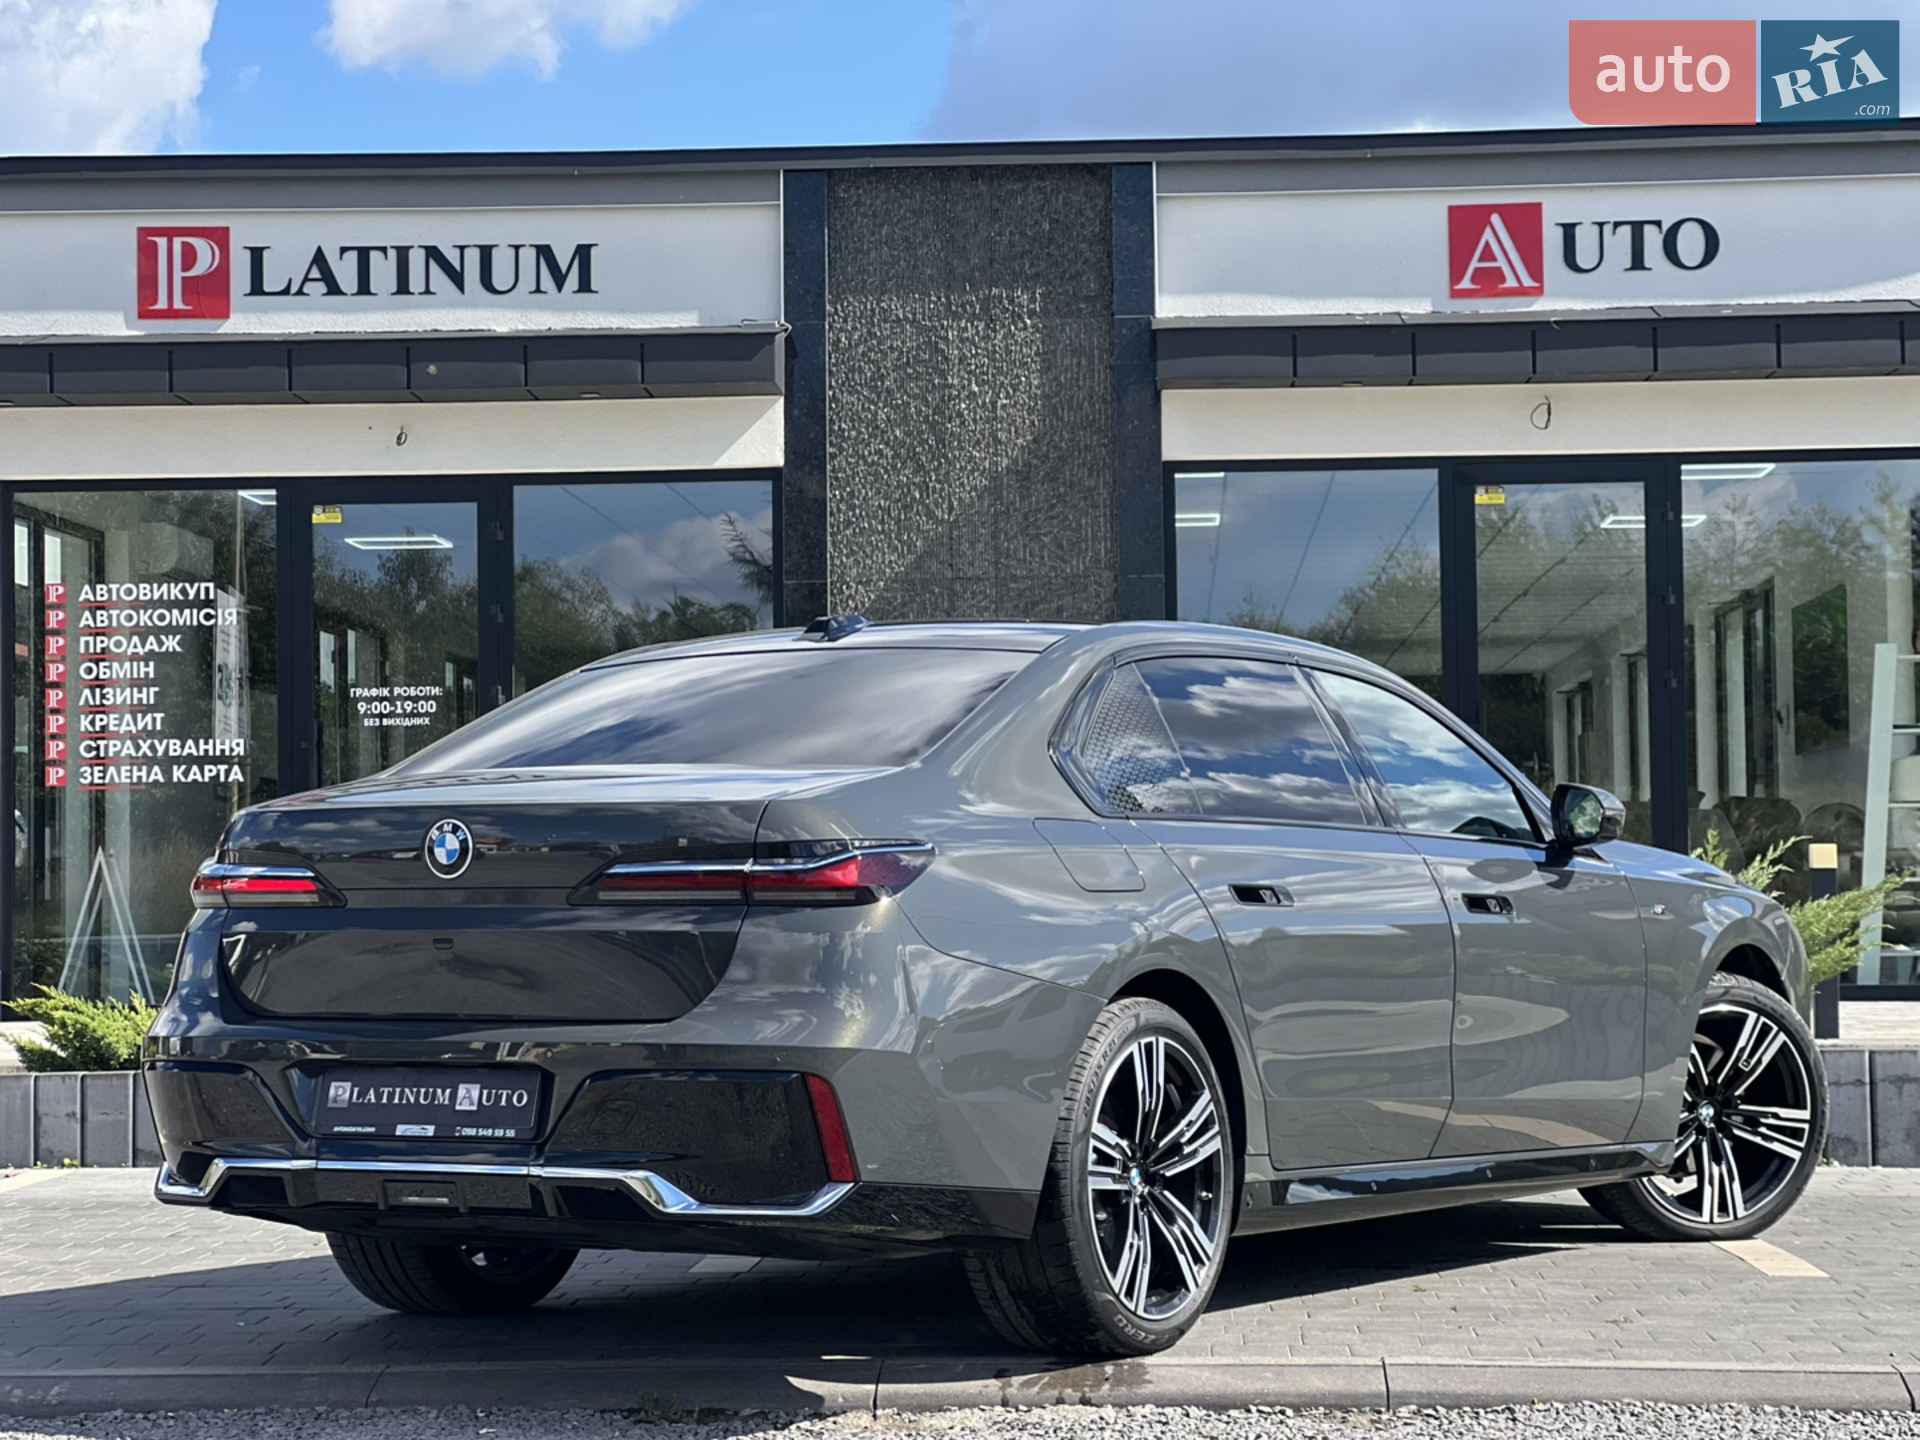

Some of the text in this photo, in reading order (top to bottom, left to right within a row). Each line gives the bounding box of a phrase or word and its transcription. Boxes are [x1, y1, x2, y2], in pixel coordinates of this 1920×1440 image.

[78, 582, 215, 602] АВТОВИКУП
[78, 608, 238, 628] АВТОКОМІСІЯ
[79, 634, 183, 655] ПРОДАЖ
[78, 661, 155, 681] ОБМІН
[78, 687, 160, 706] ЛІЗИНГ
[350, 686, 443, 697] ГРАФІК РОБОТИ:
[357, 700, 436, 714] 9:00-19:00
[79, 713, 165, 734] КРЕДИТ
[363, 716, 430, 727] БЕЗ ВИХІДНИХ
[78, 738, 245, 757] СТРАХУВАННЯ
[78, 765, 165, 784] ЗЕЛЕНА
[172, 764, 244, 783] КАРТА
[431, 823, 467, 841] BMW
[1113, 1314, 1157, 1345] ZERO
